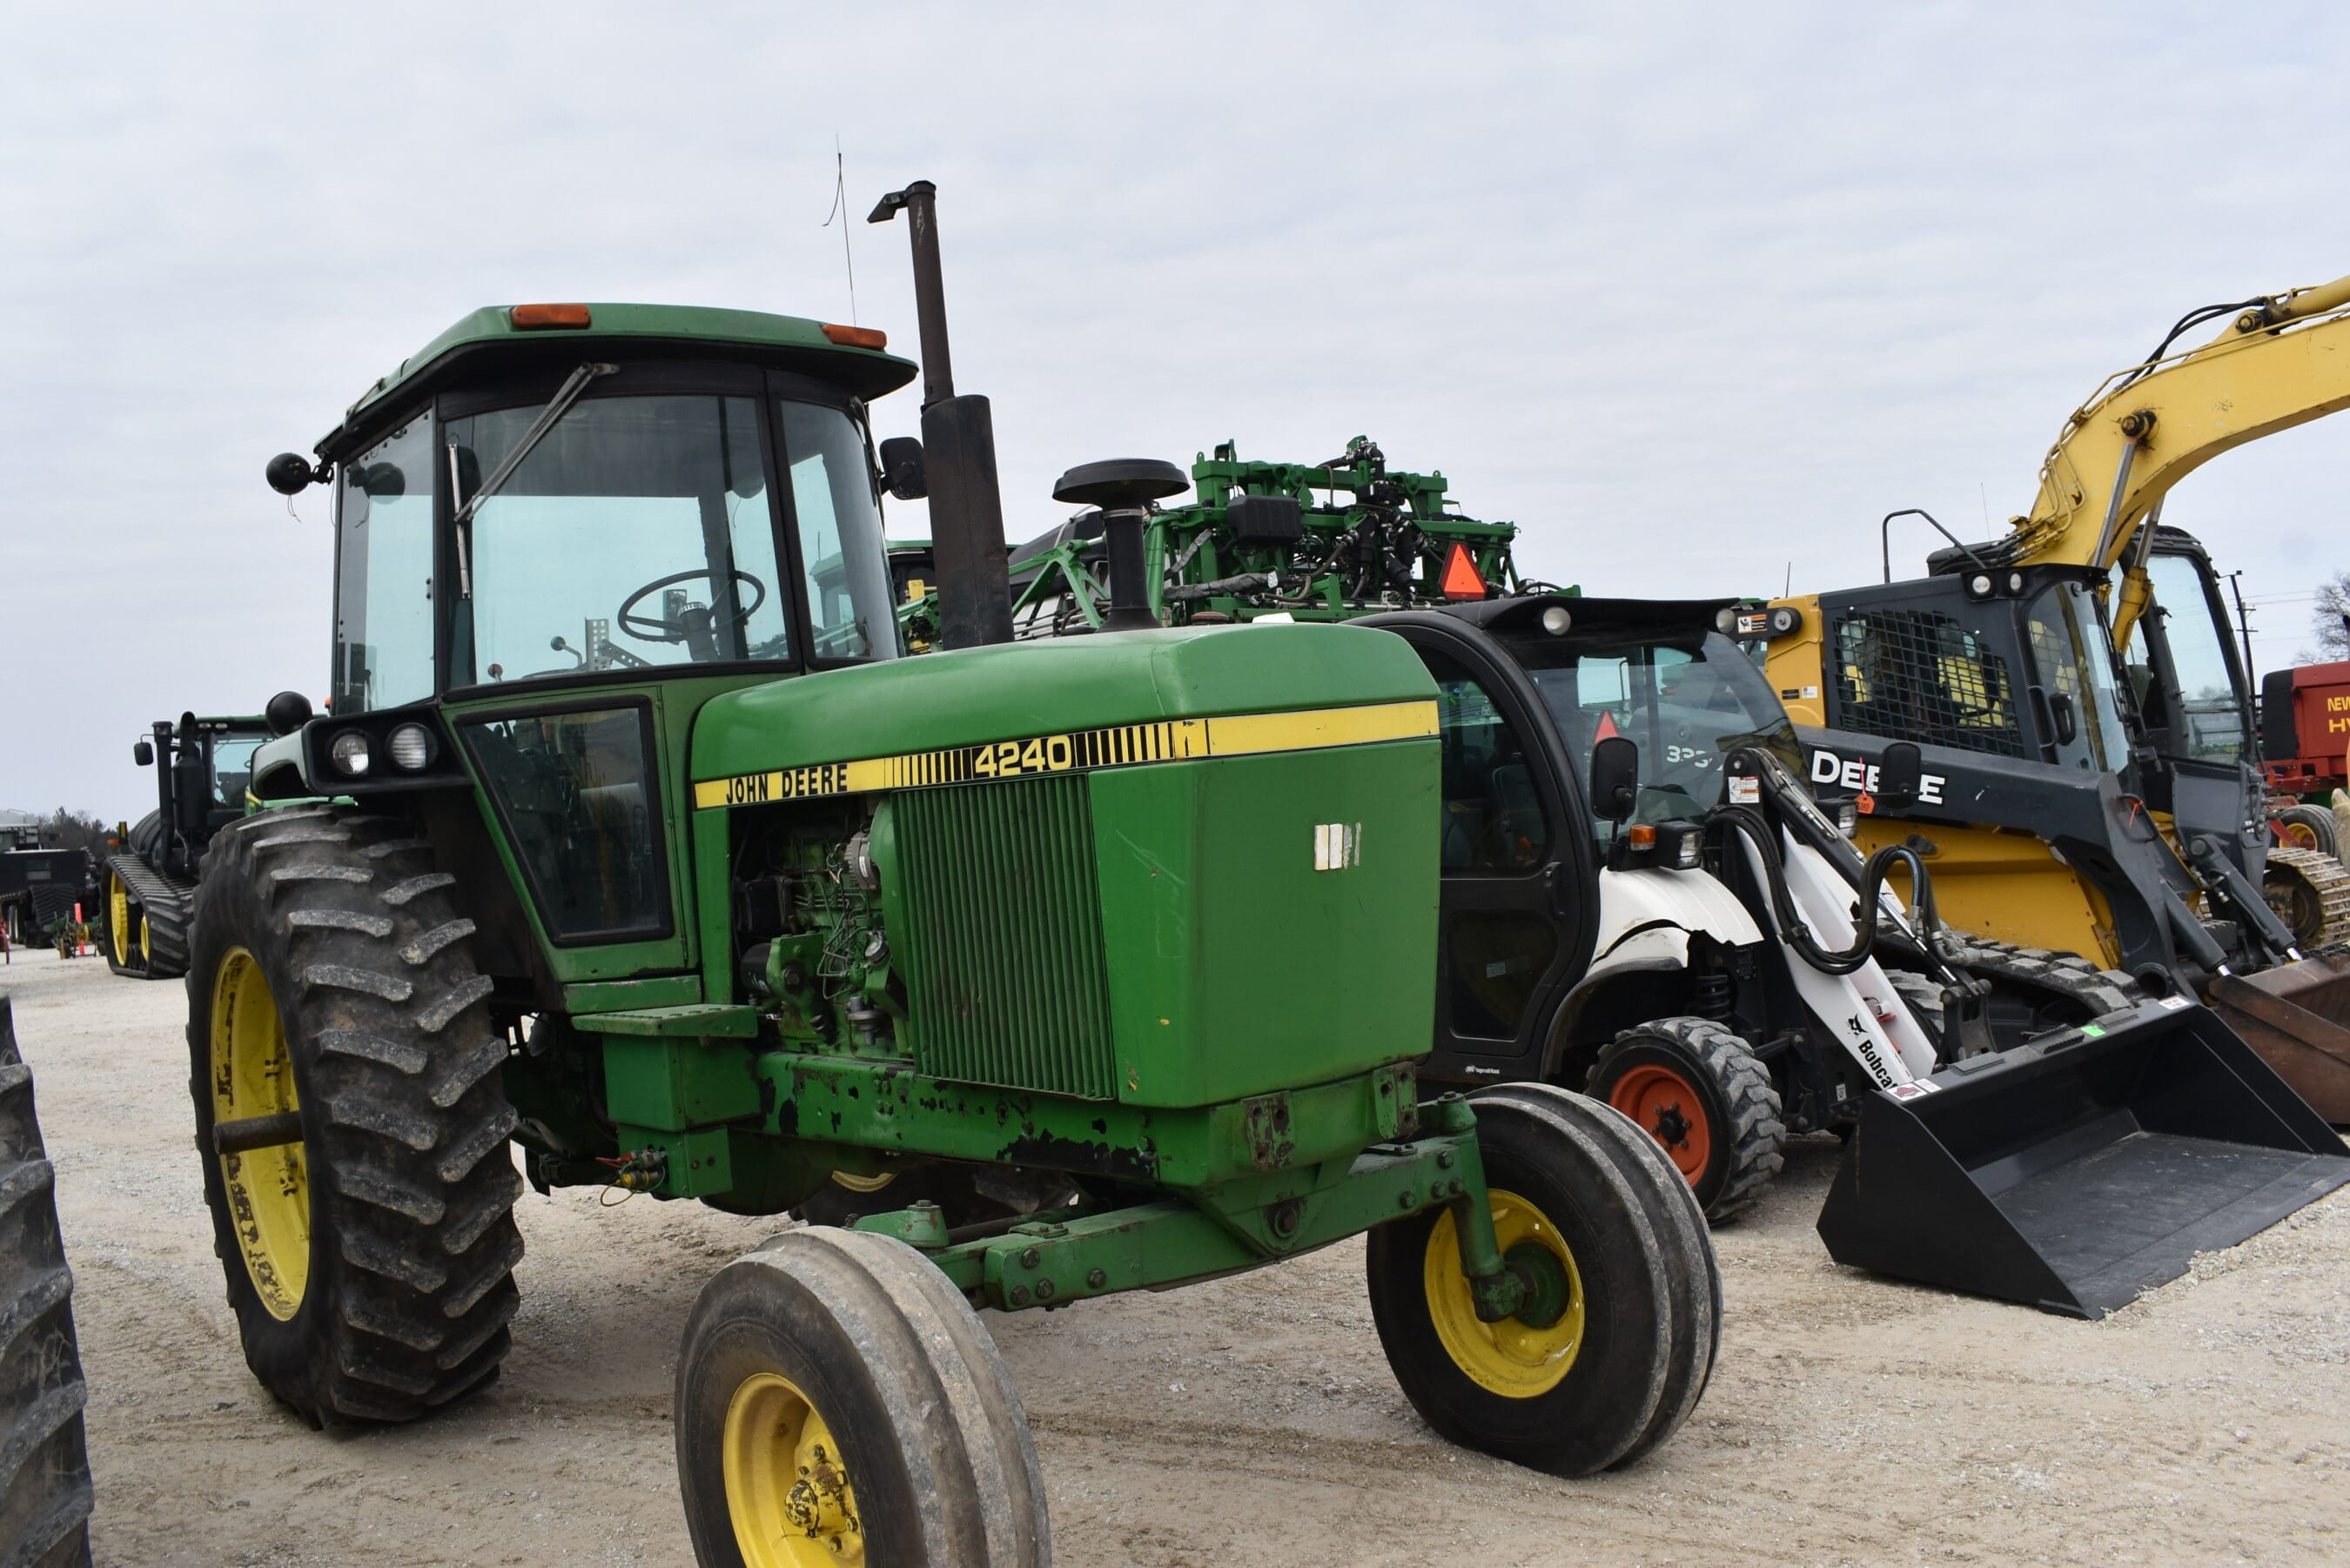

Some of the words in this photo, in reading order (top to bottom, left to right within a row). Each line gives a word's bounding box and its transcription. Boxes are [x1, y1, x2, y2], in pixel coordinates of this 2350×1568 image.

[726, 774, 769, 804] JOHN
[782, 763, 848, 798] DEERE
[975, 734, 1072, 778] 4240
[1811, 750, 1945, 805] DEEE
